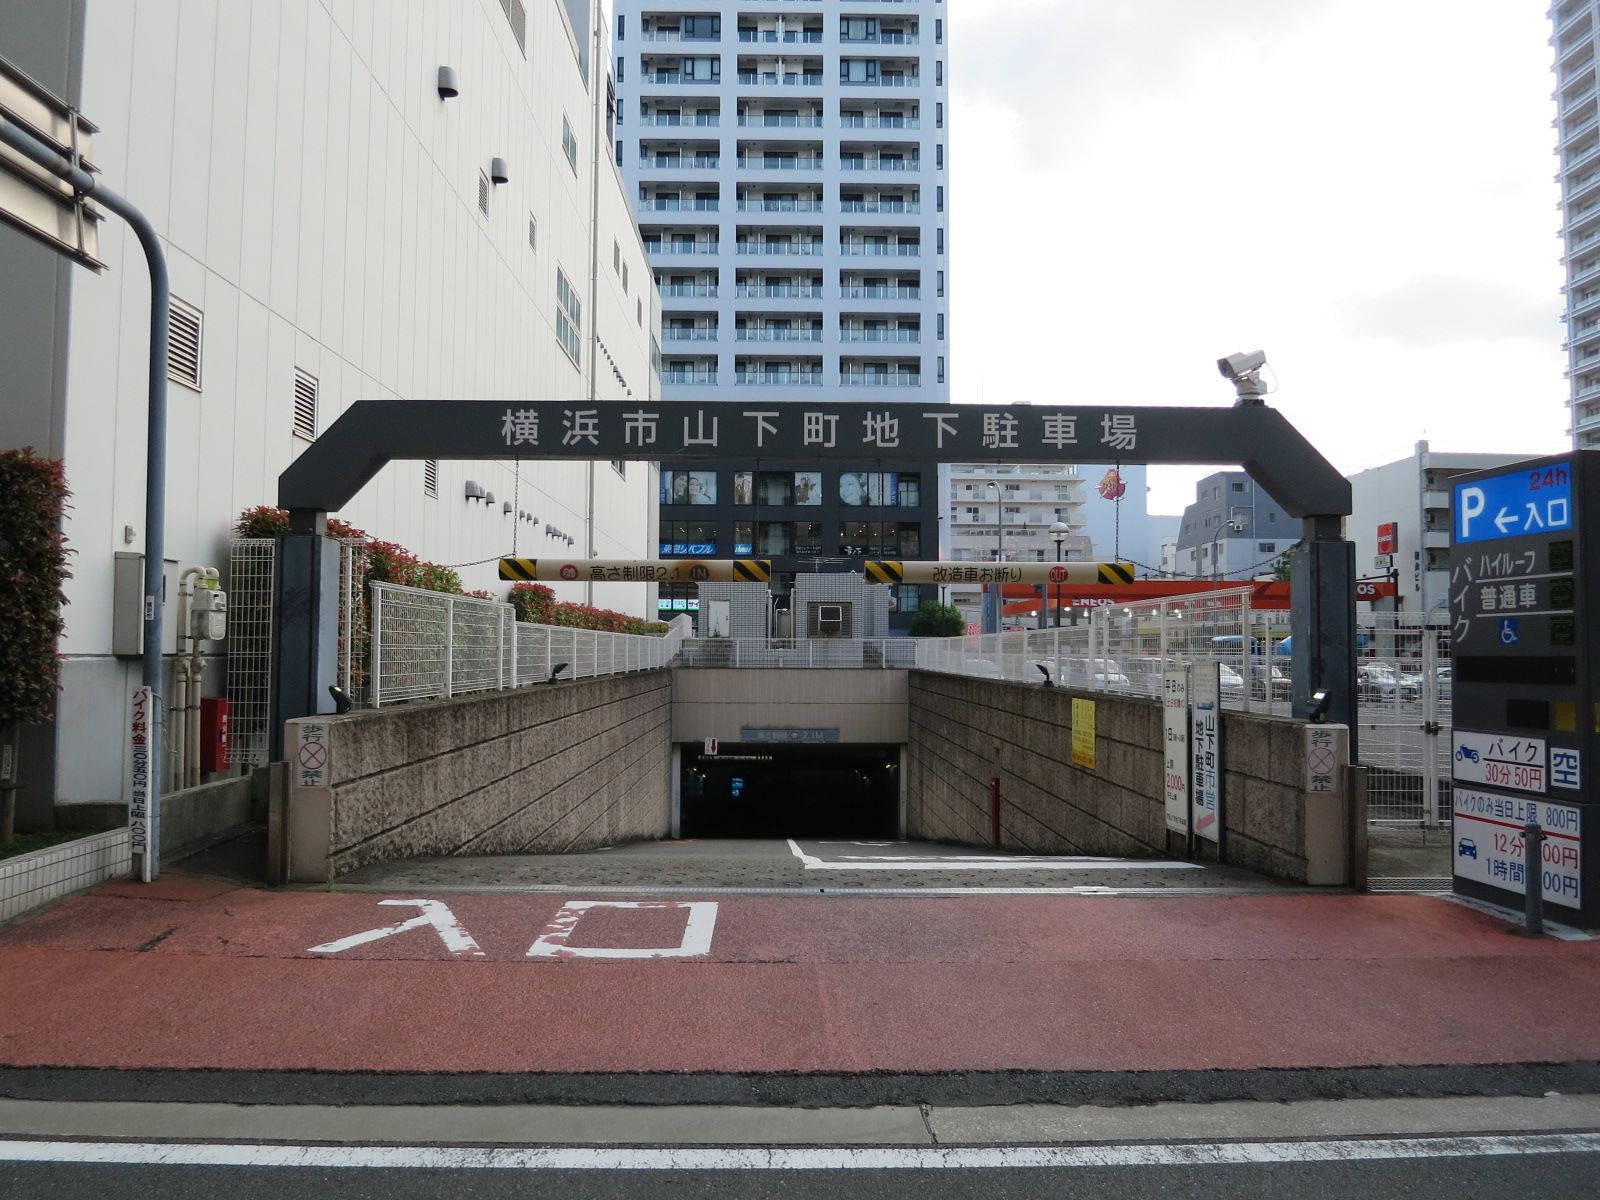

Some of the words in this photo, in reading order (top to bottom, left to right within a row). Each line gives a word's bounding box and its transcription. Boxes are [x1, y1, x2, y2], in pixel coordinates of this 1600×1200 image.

[500, 410, 1138, 450] 横浜市山下町地下駐車場
[1529, 468, 1568, 491] 24h
[1461, 487, 1485, 537] P
[1524, 498, 1568, 530] 入口
[691, 566, 708, 580] IN
[932, 566, 1022, 583] 改造車お断り
[1051, 568, 1067, 581] OUT
[1479, 551, 1535, 578] ハイルーフ
[1452, 557, 1473, 642] バイク
[1480, 584, 1536, 609] 普通車
[303, 725, 323, 742] 歩行
[1311, 730, 1333, 747] 歩行
[1488, 739, 1538, 762] バイク
[301, 770, 323, 786] 禁止
[1485, 763, 1511, 785] 30分
[1514, 768, 1542, 790] 50円
[1552, 752, 1578, 785] 空
[1310, 775, 1332, 792] 禁止
[1455, 793, 1538, 824] バイクのみ当日上限
[1545, 808, 1578, 831] 800円
[1493, 832, 1525, 857] 12分
[1486, 858, 1525, 885] 1時間
